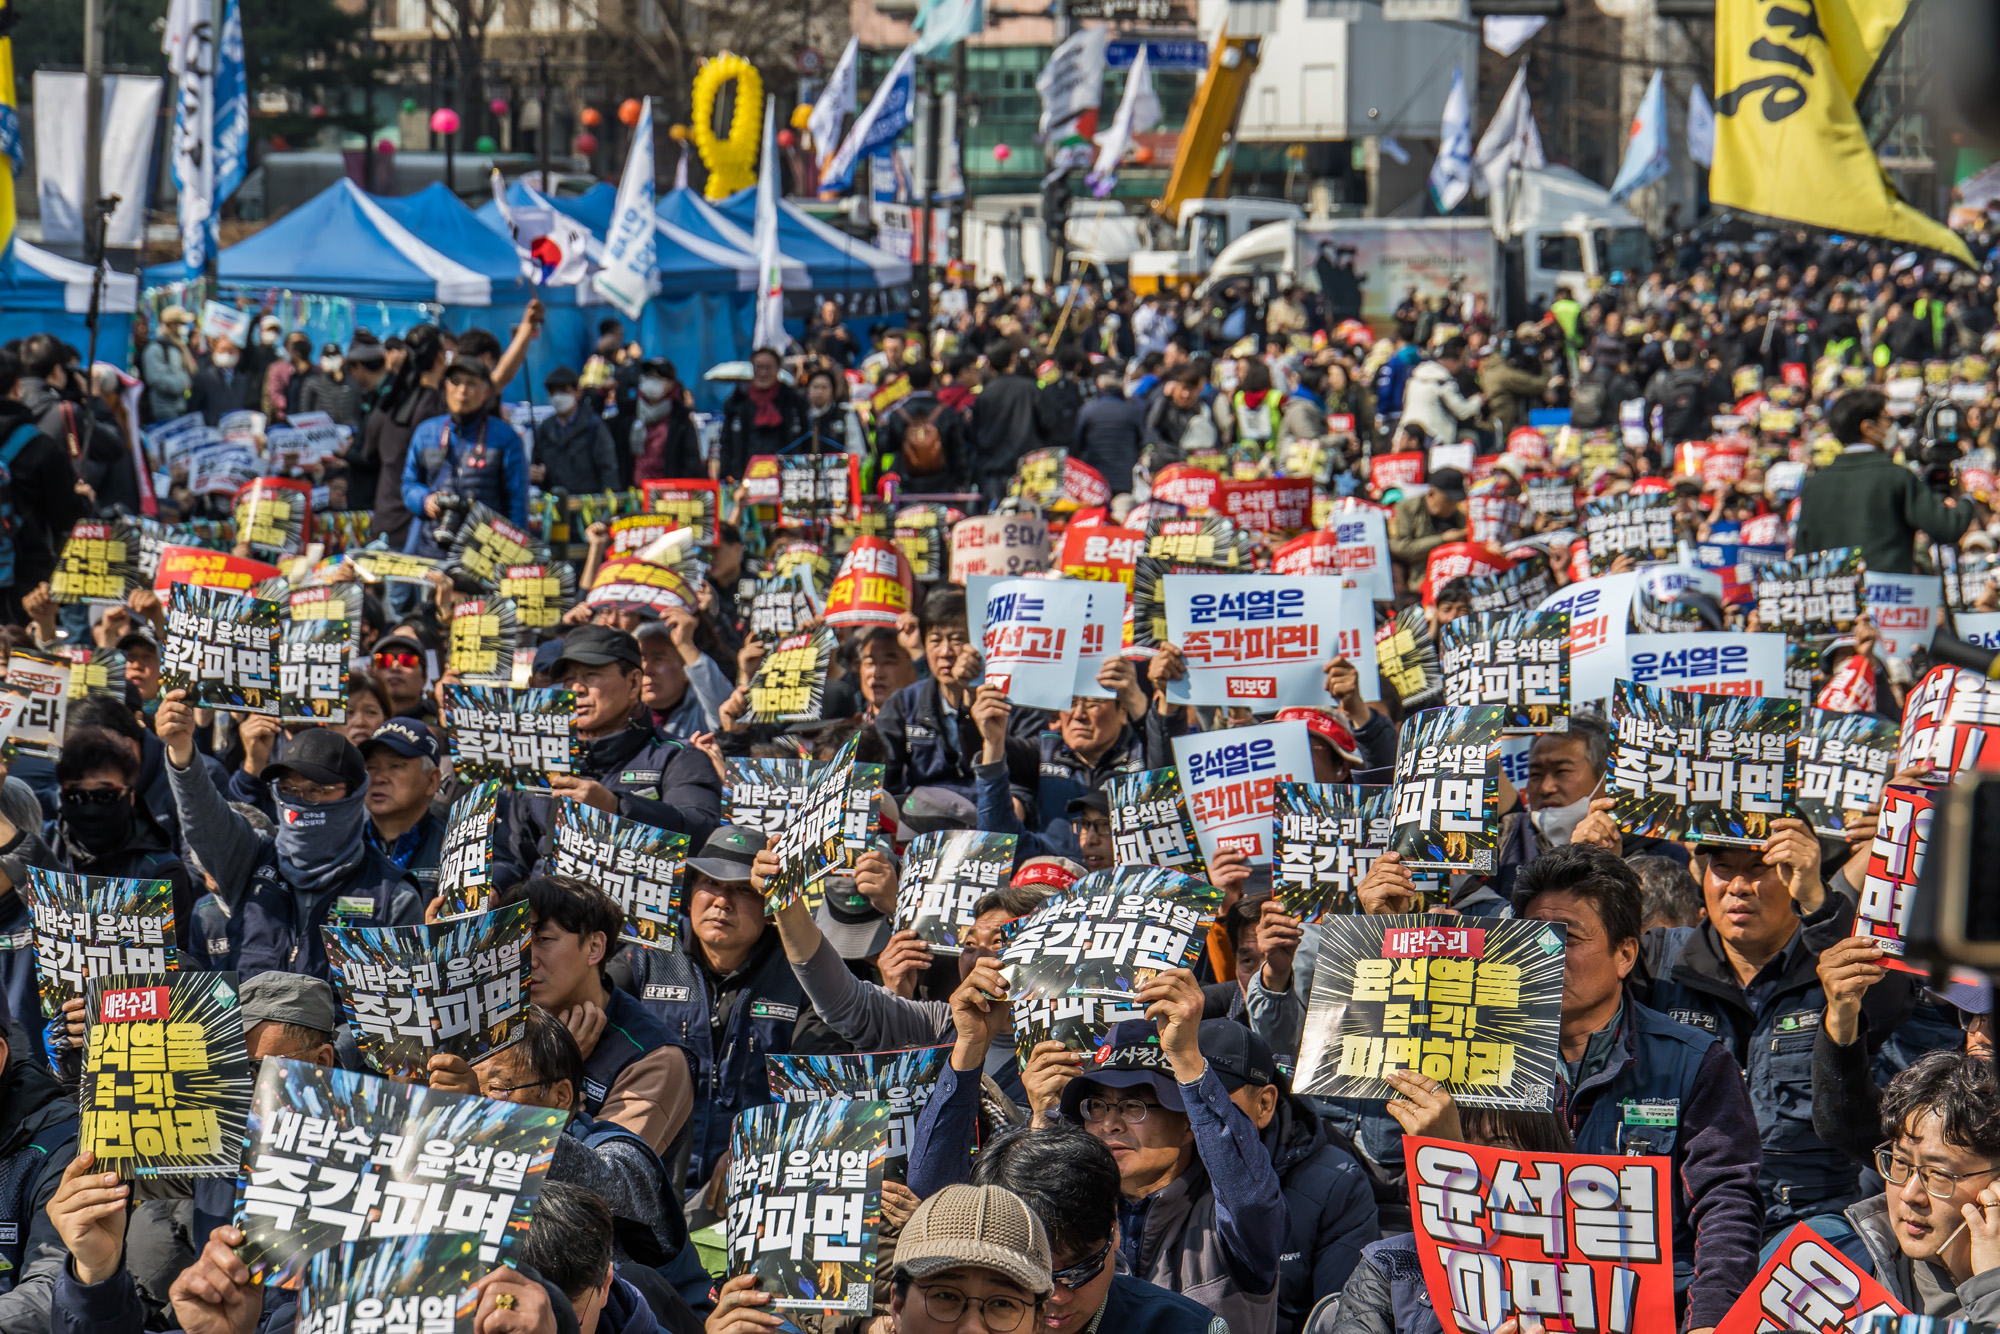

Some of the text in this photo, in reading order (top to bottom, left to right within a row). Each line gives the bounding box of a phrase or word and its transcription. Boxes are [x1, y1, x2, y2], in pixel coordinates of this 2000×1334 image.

[1191, 589, 1305, 625] 윤석열은
[1758, 593, 1858, 626] 즉각파면
[168, 609, 271, 648] 내란수괴 윤석열
[1183, 624, 1319, 663] 즉각파면!
[164, 635, 273, 691] 즉각파면
[1444, 639, 1491, 675] 내란수괴
[1495, 638, 1560, 663] 윤석열
[1631, 645, 1749, 682] 윤석열은
[1229, 678, 1272, 696] 진보당
[1445, 664, 1561, 706] 즉각파면
[454, 709, 569, 736] 내란수괴 윤석열
[1618, 716, 1787, 762] 내란수괴 윤석열
[456, 729, 571, 772] 즉각파면
[1188, 739, 1276, 785] 윤석열은
[1418, 745, 1487, 775] 윤석열
[1822, 740, 1889, 773] 윤석열
[1613, 747, 1785, 814] 즉각파면
[1798, 762, 1886, 812] 파면
[457, 811, 490, 846] 윤석열
[1122, 799, 1181, 831] 윤석열
[1282, 815, 1363, 844] 내란수괴
[558, 826, 674, 885] 내란수괴 윤석열
[1115, 823, 1194, 868] 파면
[940, 861, 1001, 883] 윤석열
[34, 904, 164, 944] 내란수괴 윤석열
[1022, 895, 1200, 935] 내란수괴 윤석열
[1001, 921, 1190, 971] 즉각파면
[1392, 929, 1468, 955] 내란수괴
[342, 939, 522, 993] 내란수괴 윤석열
[1352, 957, 1522, 1009] 윤석열을
[351, 968, 522, 1047] 즉각파면
[646, 985, 688, 999] 단결투쟁
[87, 1022, 209, 1074] 윤석열을
[1337, 1036, 1517, 1087] 파면하라
[262, 1110, 532, 1193] 내란수괴 윤석열
[784, 1149, 871, 1190] 윤석열
[243, 1153, 516, 1265] 즉각파면
[1416, 1146, 1662, 1264] 윤석열
[727, 1193, 867, 1269] 즉각파면
[1436, 1245, 1641, 1334] 파면!
